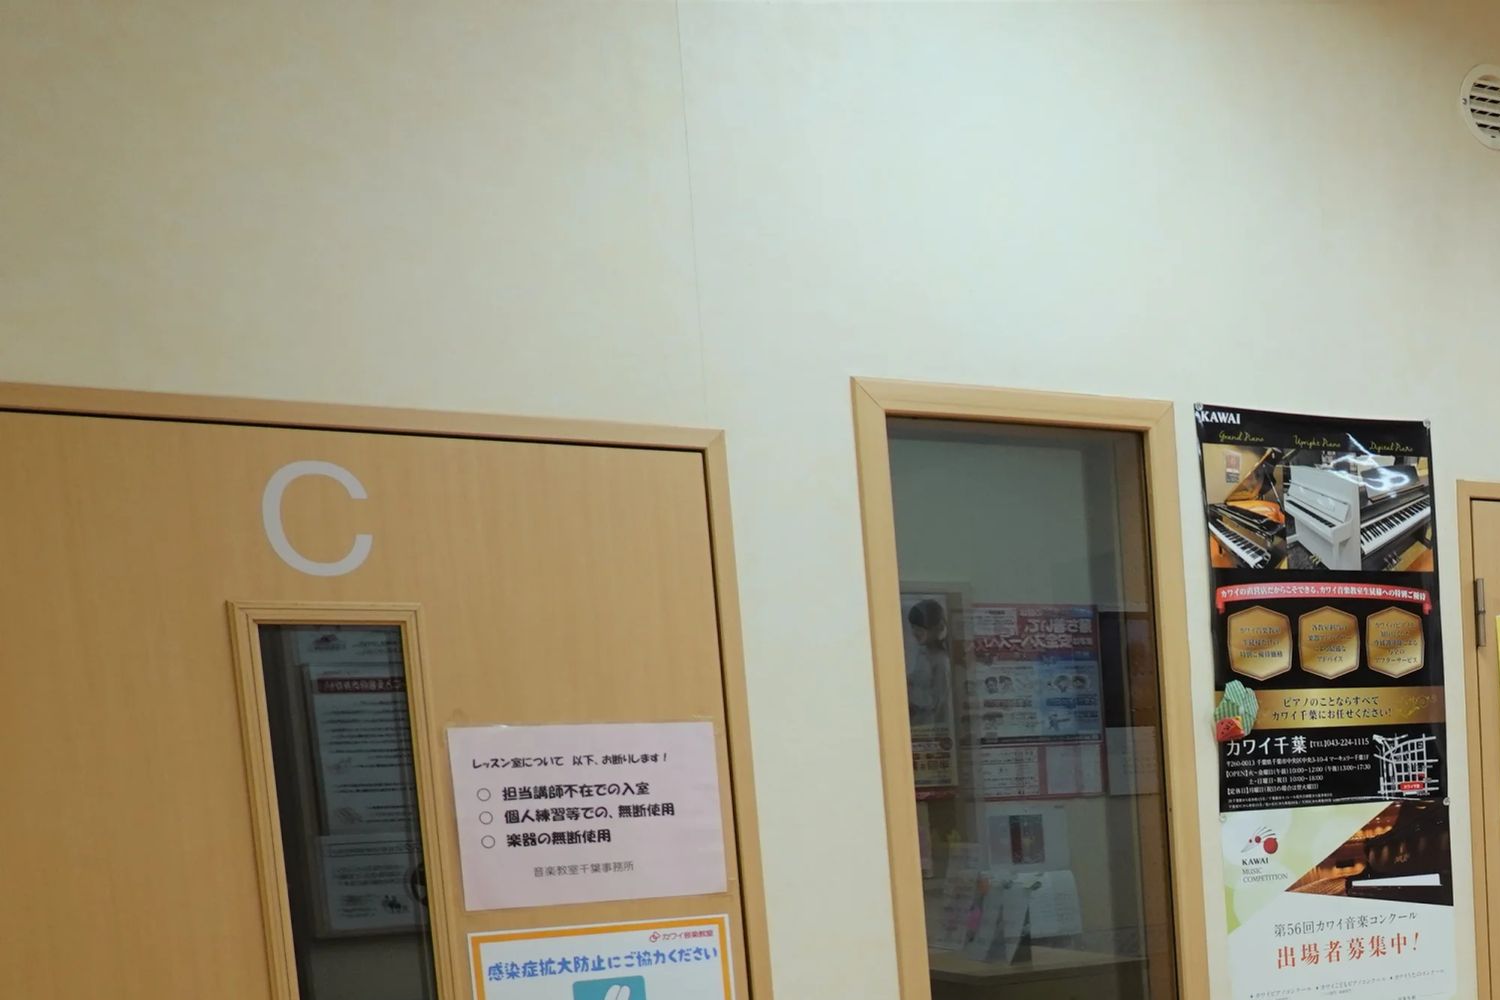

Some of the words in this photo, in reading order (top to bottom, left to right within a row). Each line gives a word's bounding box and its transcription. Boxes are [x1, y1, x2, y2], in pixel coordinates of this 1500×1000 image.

[1201, 411, 1241, 425] KAWAI
[262, 460, 373, 576] C
[1283, 696, 1379, 708] ピアノのことならすべて
[1226, 735, 1307, 757] カワイ千葉
[472, 755, 564, 770] レッスン室について
[502, 781, 650, 802] 担当講師不在での入室
[504, 802, 676, 825] 個人練習等での、無断使用
[506, 829, 612, 848] 楽器の無断使用
[533, 860, 635, 878] 音楽教室千葉事務所
[1242, 857, 1269, 866] KAWAI
[1242, 873, 1288, 883] COMPETITION
[1274, 912, 1417, 937] 第56回カワイ音楽コンクール
[487, 946, 719, 981] 感染症拡大防止にご協力ください
